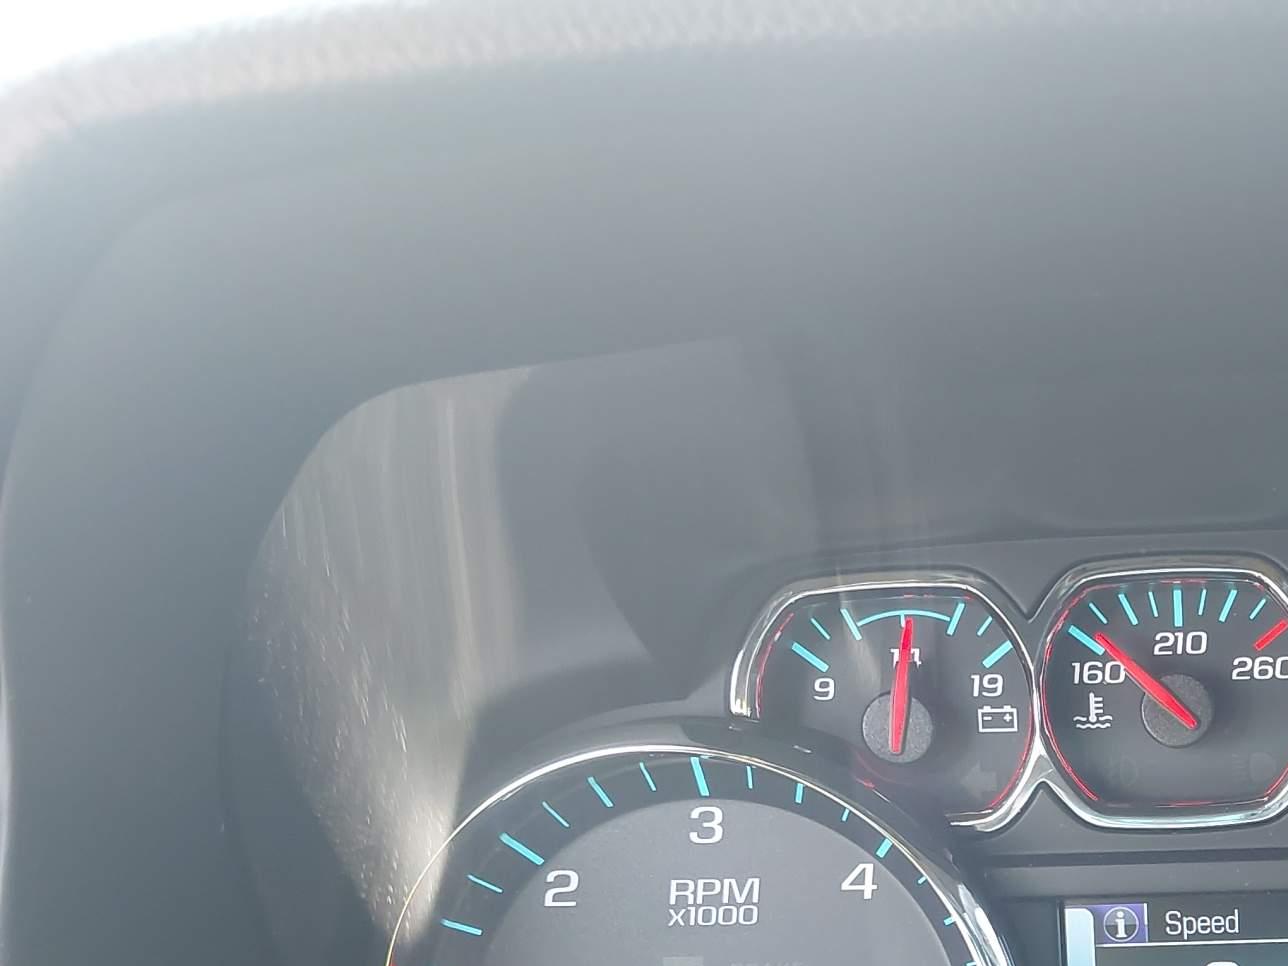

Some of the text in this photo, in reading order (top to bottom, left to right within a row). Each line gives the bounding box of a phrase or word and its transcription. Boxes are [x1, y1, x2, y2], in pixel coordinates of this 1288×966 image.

[1153, 631, 1208, 655] 210
[1071, 660, 1126, 684] 160
[813, 677, 835, 701] 9
[970, 673, 1004, 697] 19
[689, 806, 723, 844] 3
[544, 869, 579, 907] 2
[669, 877, 760, 904] RPM
[841, 863, 878, 900] 4
[668, 904, 758, 927] x1000
[1165, 909, 1240, 940] Speed
